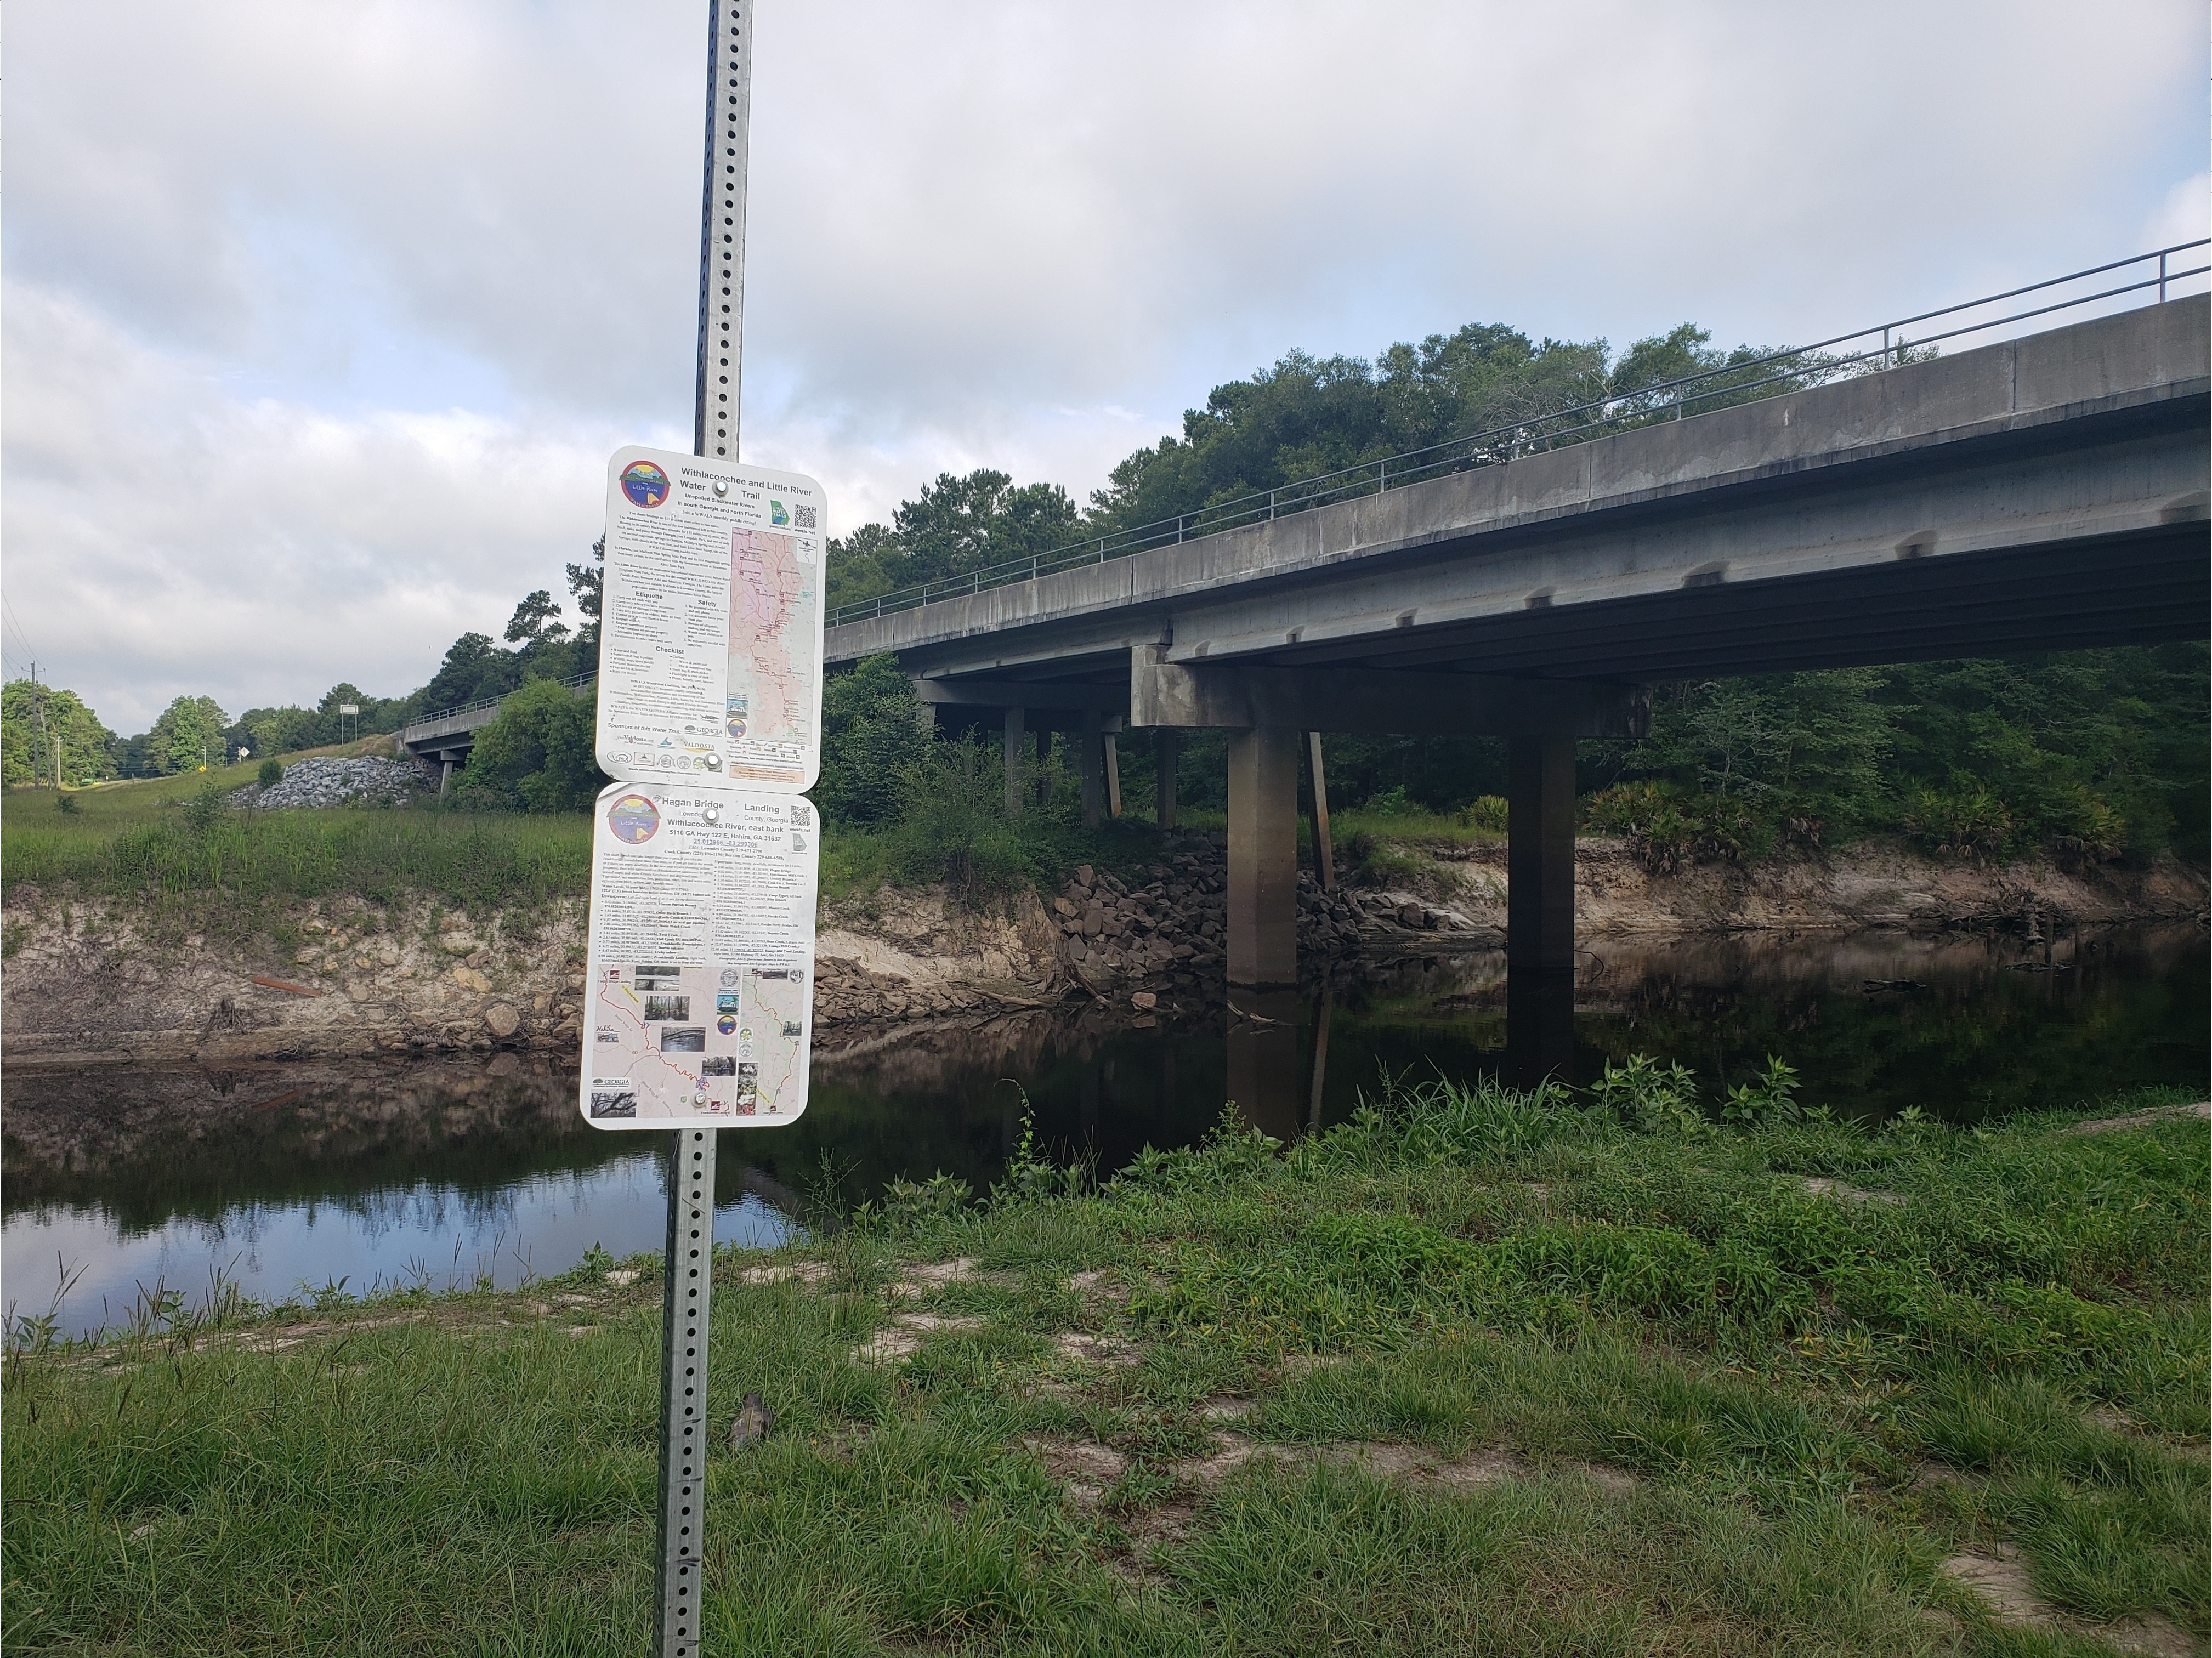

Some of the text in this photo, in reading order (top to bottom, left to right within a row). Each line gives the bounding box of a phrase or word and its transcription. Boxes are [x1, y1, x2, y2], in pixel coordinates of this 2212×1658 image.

[682, 468, 812, 496] Withlacoochee and Little River
[680, 480, 760, 499] Water Trail
[685, 493, 710, 502] Unspoiled
[711, 497, 738, 506] Blackwater
[636, 591, 663, 600] Etiquette
[697, 599, 716, 607] Safety
[656, 646, 684, 654] Checklist
[662, 798, 779, 814] Hagan Bridge Landing
[667, 819, 723, 828] Withlacoochee
[725, 822, 746, 831] River,
